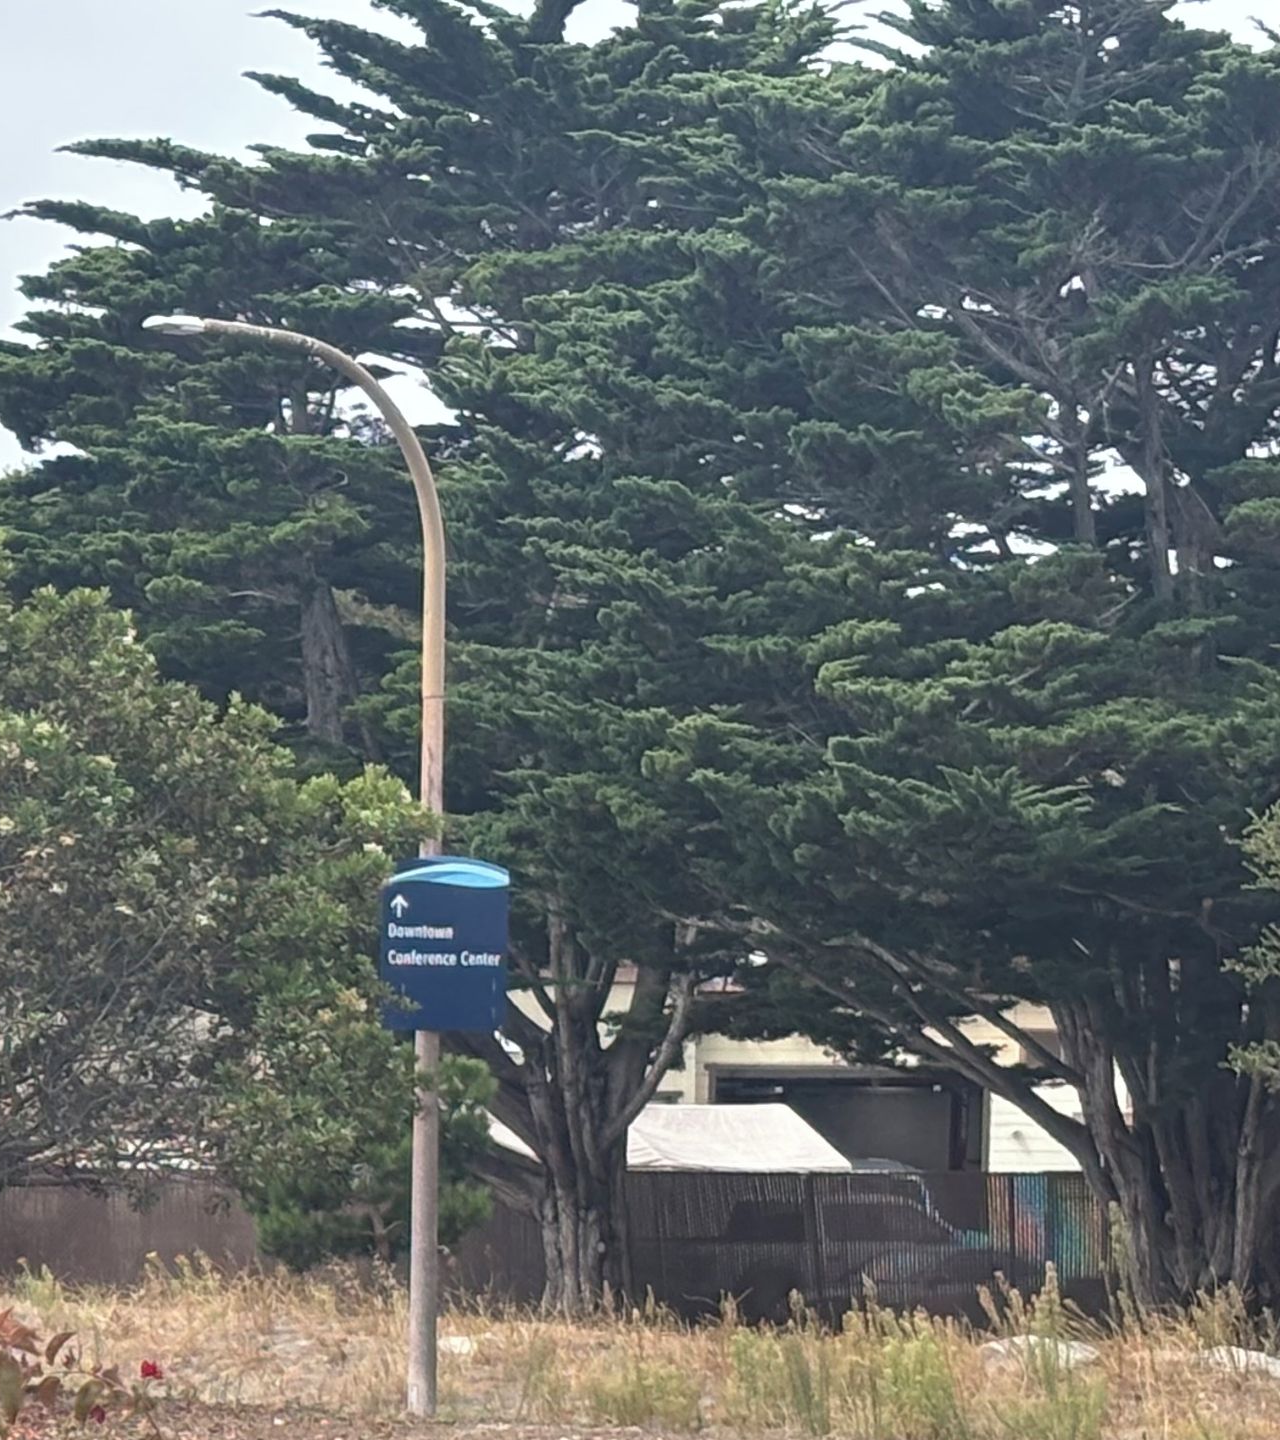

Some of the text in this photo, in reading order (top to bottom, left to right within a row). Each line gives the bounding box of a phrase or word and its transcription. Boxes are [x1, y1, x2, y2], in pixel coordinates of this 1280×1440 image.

[388, 922, 454, 939] Downtown
[387, 949, 501, 967] Conference Center
